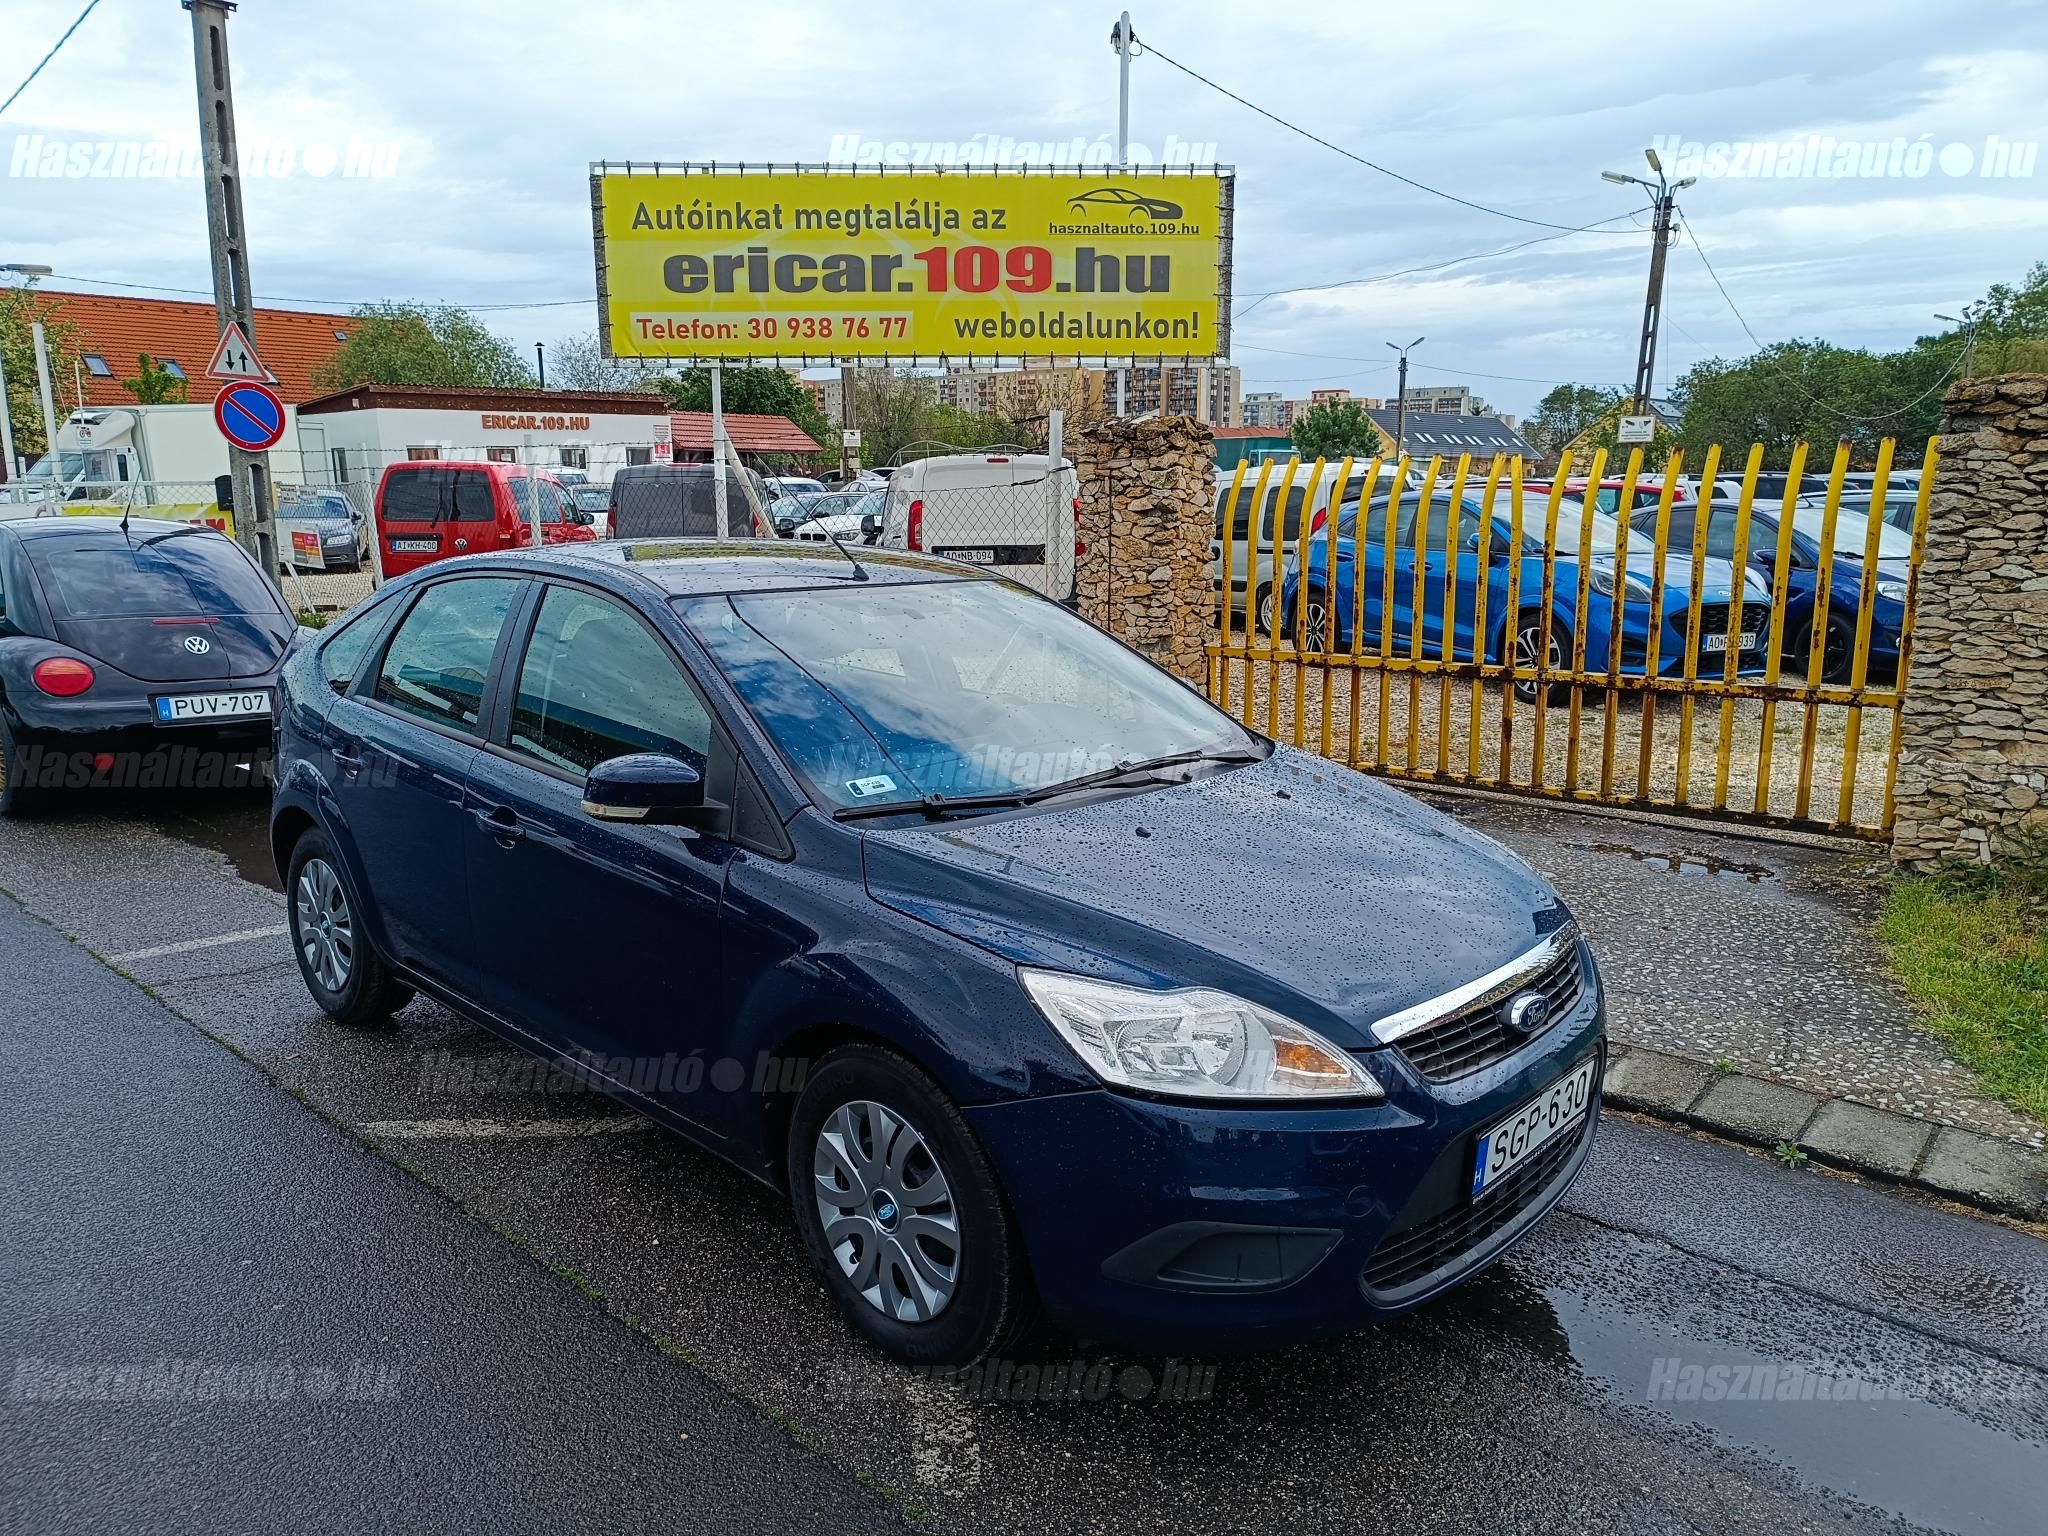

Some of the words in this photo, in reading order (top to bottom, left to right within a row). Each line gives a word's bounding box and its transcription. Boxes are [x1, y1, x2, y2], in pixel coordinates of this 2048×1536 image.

[632, 197, 784, 232] Autóinkat
[795, 197, 960, 237] megtalálja
[972, 206, 1007, 230] az
[1049, 222, 1200, 236] hasznaltauto.109.hu
[663, 246, 1171, 293] ericar.109.hu
[636, 317, 739, 340] Telefon:
[748, 318, 776, 339] 30
[787, 317, 831, 339] 938
[842, 317, 870, 339] 76
[878, 317, 907, 339] 77
[954, 311, 1199, 340] weboldalunkon!
[481, 415, 590, 430] ERICAR.109.HU
[175, 695, 264, 715] PUV-707
[1491, 1070, 1589, 1174] SGP-630
